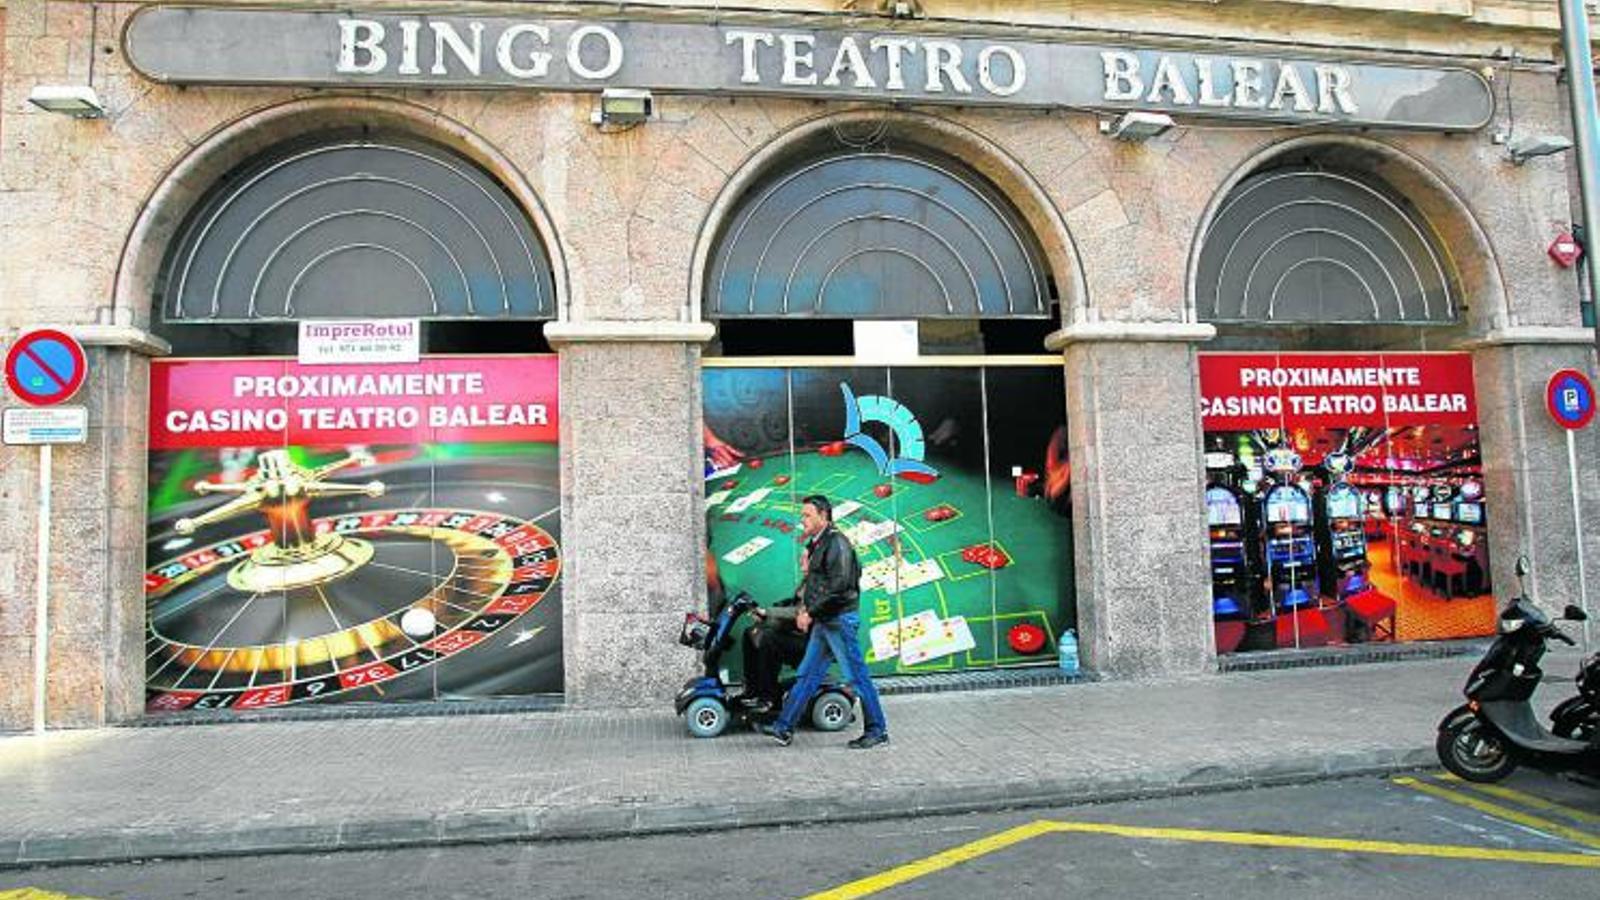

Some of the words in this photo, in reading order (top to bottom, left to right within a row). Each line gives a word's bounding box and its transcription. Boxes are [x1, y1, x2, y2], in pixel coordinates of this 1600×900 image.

[336, 19, 624, 79] BINGO
[725, 31, 1027, 96] TEATRO
[1100, 51, 1359, 114] BALEAR
[306, 322, 413, 340] ImpreRotul
[233, 373, 484, 398] PROXIMAMENTE
[1240, 367, 1421, 388] PROXIMAMENTE
[1200, 396, 1282, 417] CASINO
[1288, 395, 1377, 415] TEATRO
[1383, 393, 1468, 412] BALEAR
[166, 408, 288, 433] CASINO
[298, 405, 419, 430] TEATRO
[428, 404, 548, 428] BALEAR
